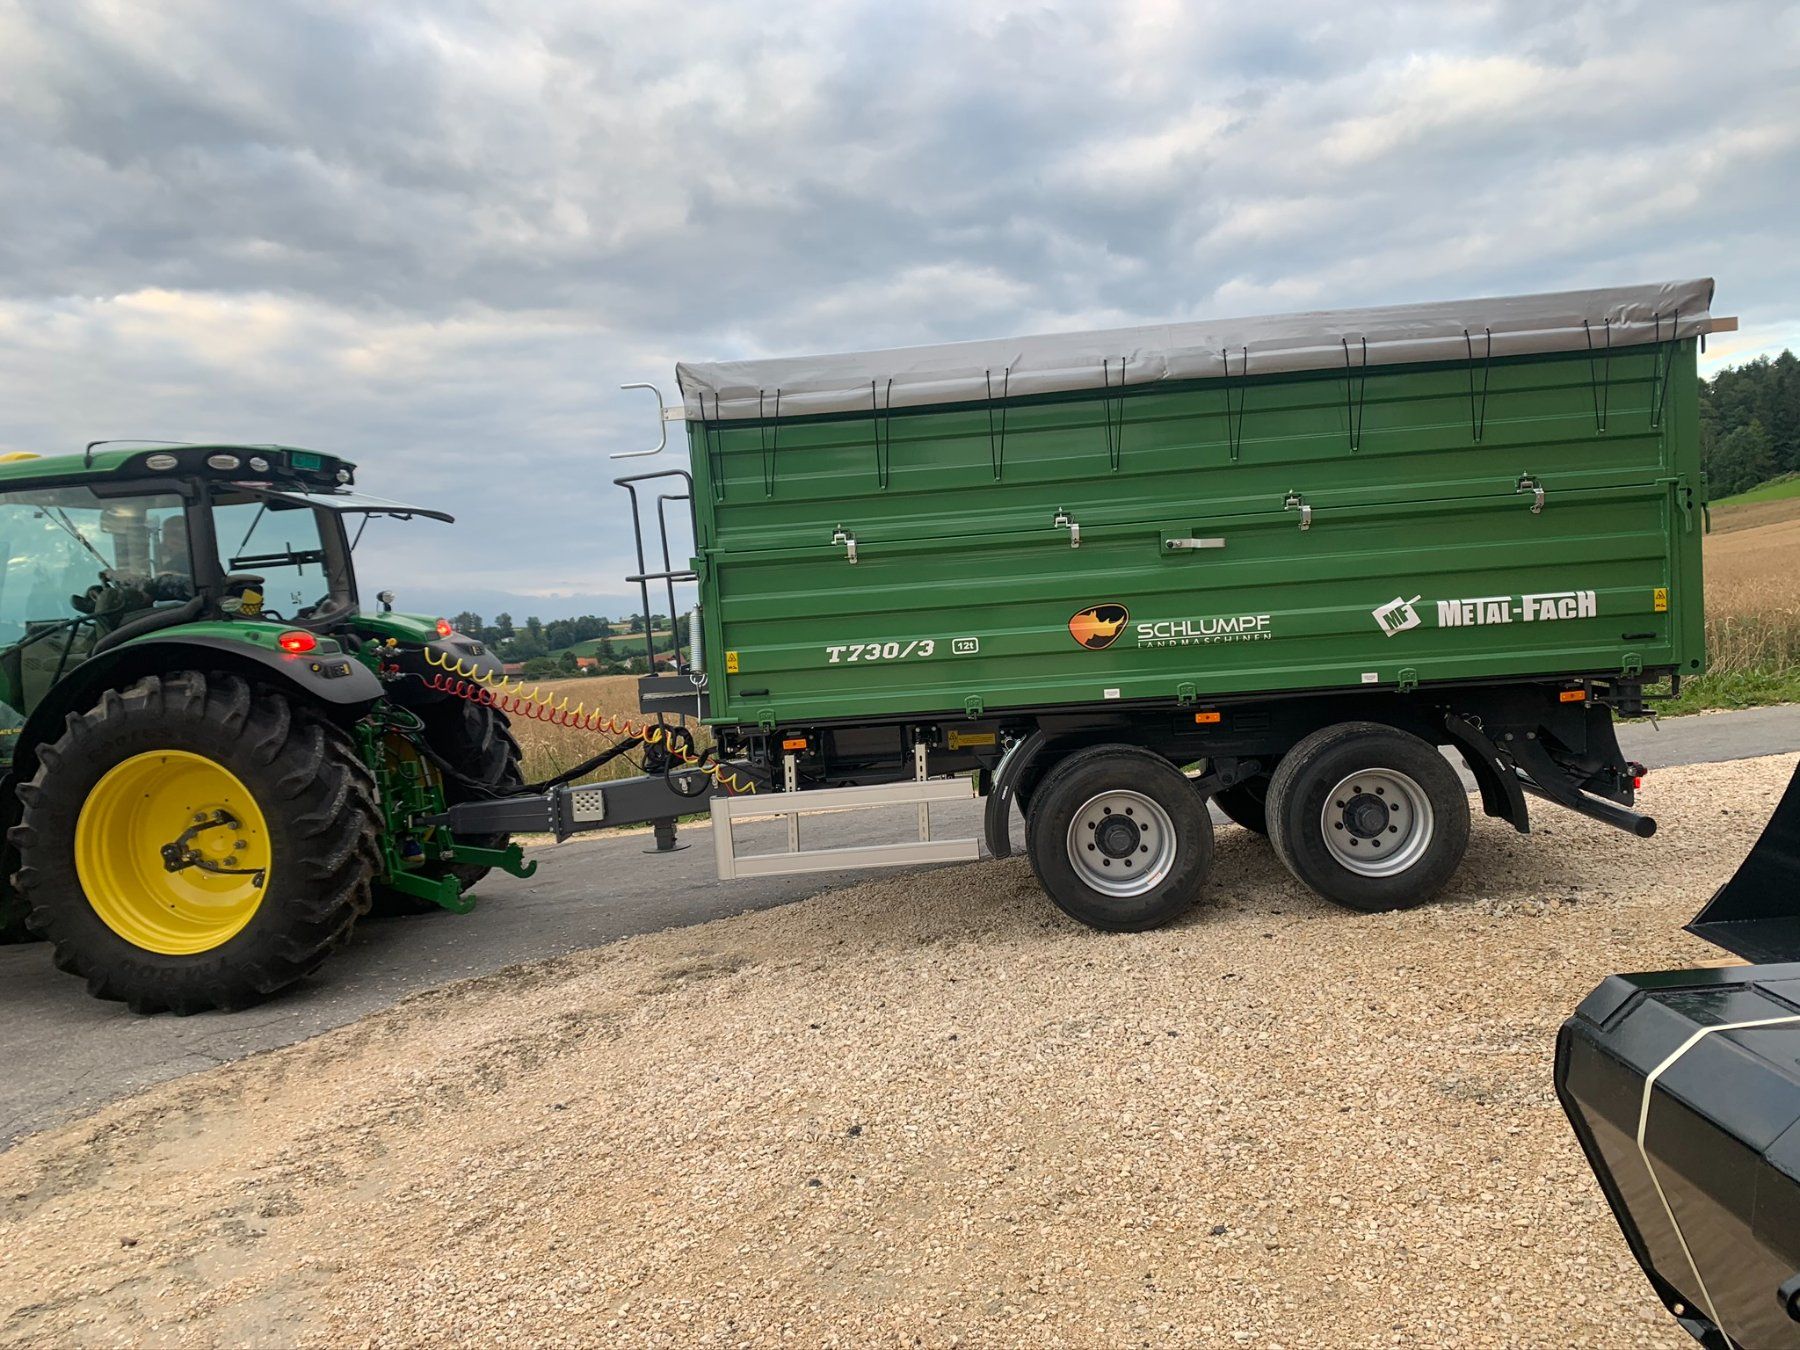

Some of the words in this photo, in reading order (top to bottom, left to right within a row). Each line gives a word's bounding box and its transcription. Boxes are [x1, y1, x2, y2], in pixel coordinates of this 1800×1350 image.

[1381, 602, 1412, 631] MF
[1436, 590, 1597, 628] METAL-FACH
[1136, 615, 1271, 639] SCHLUMPF
[826, 640, 935, 663] T730/3
[957, 641, 975, 650] 12t
[1137, 633, 1272, 649] LANDMASCHINEN
